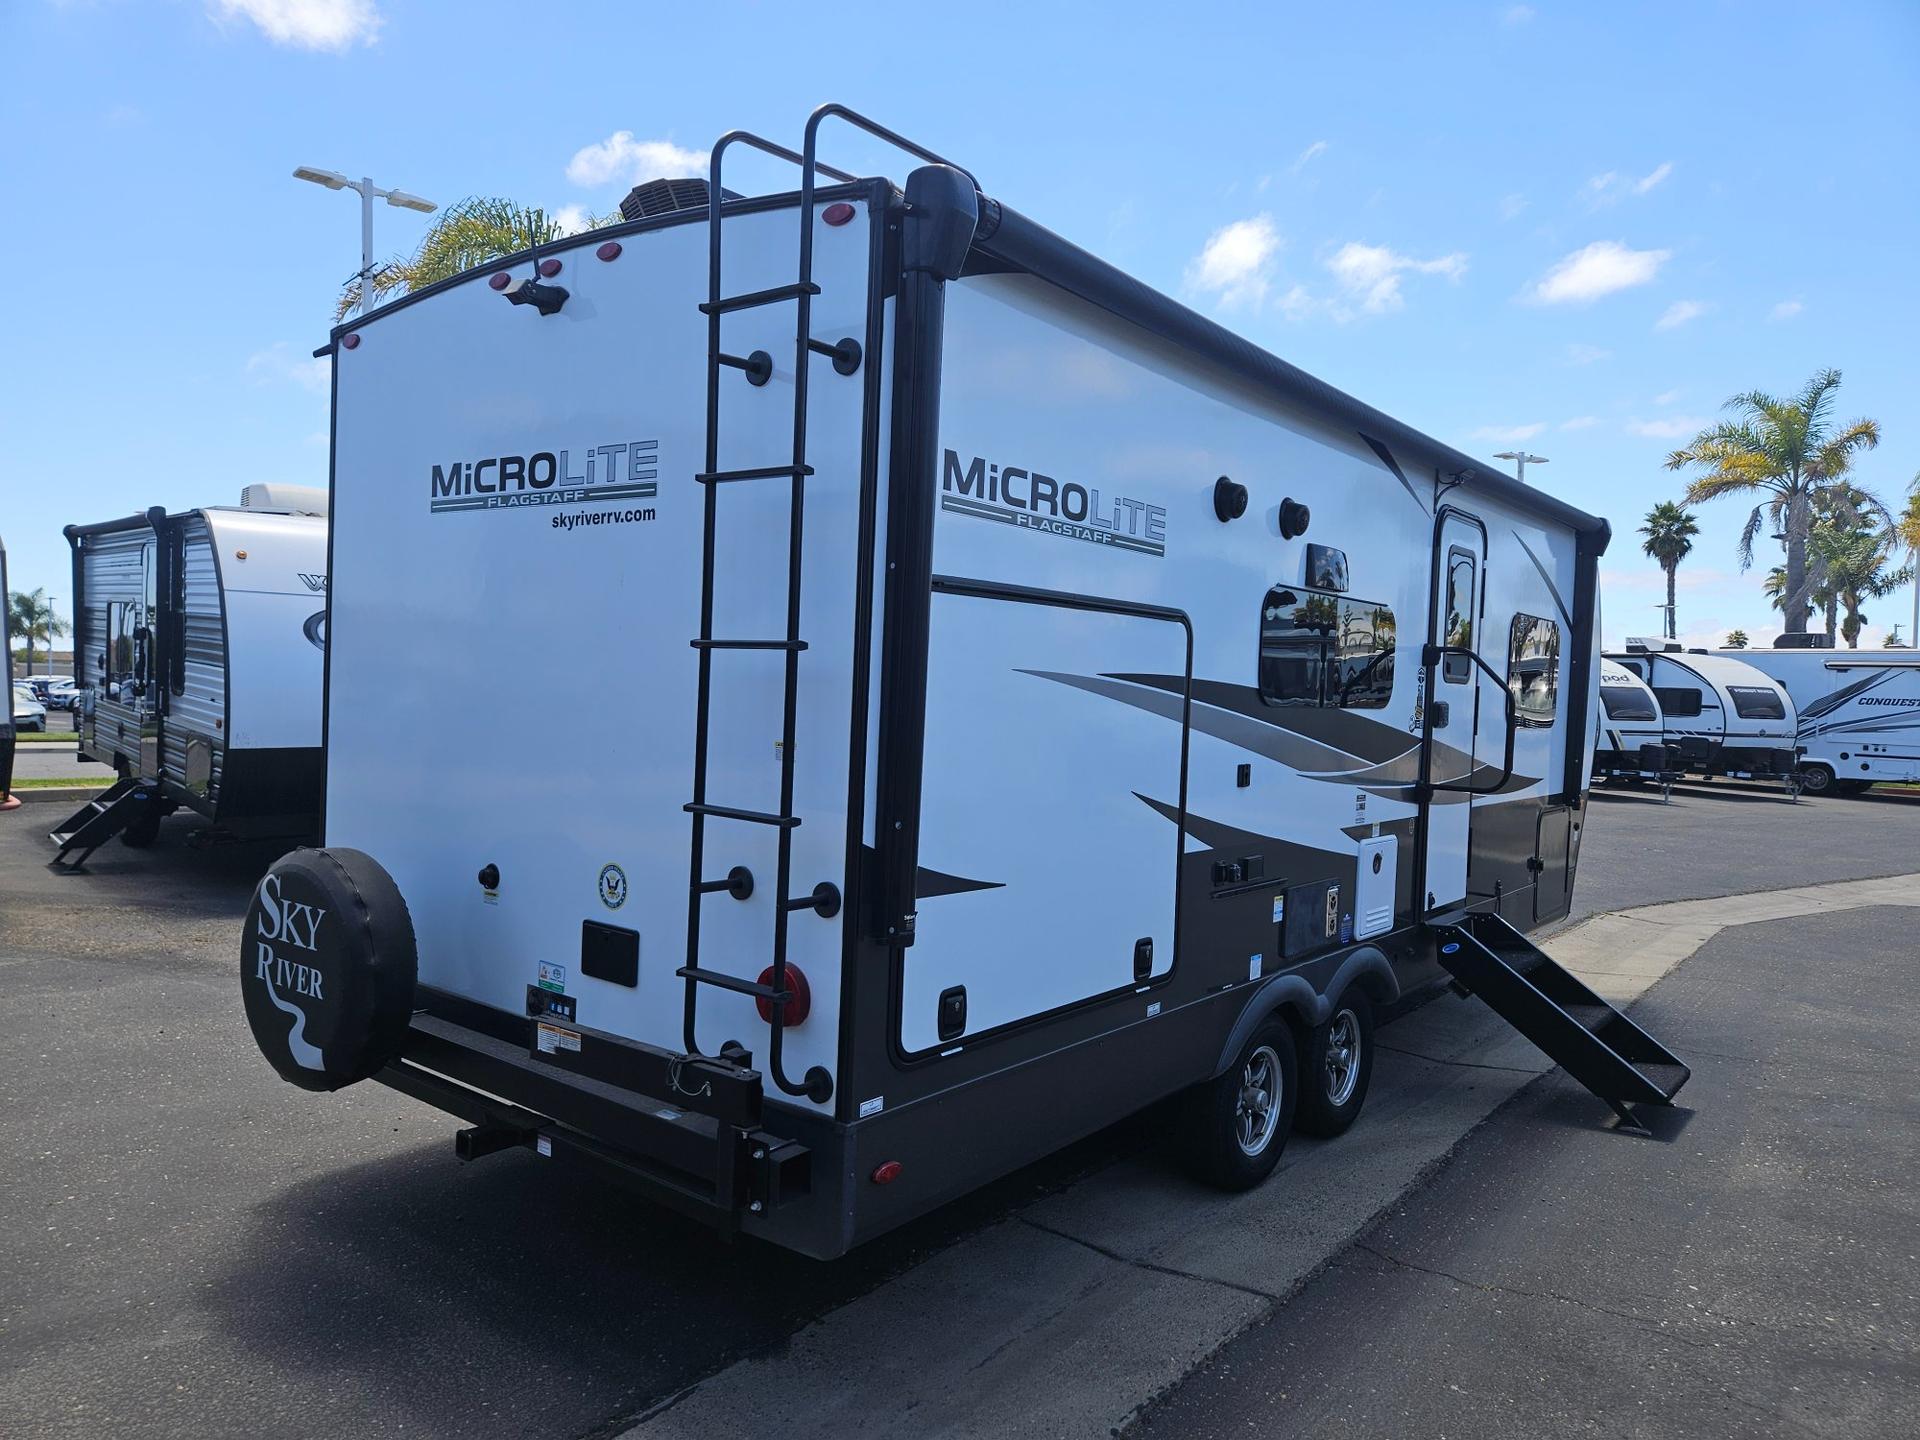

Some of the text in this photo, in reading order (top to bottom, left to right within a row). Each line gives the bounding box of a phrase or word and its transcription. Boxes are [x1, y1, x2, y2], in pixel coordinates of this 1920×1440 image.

[487, 489, 585, 508] FLAGSTAFF
[552, 507, 656, 531] skyriverrv.com
[1016, 513, 1112, 544] FLAGSTAFF
[258, 874, 326, 951] SKY
[256, 941, 323, 1001] RIVER
